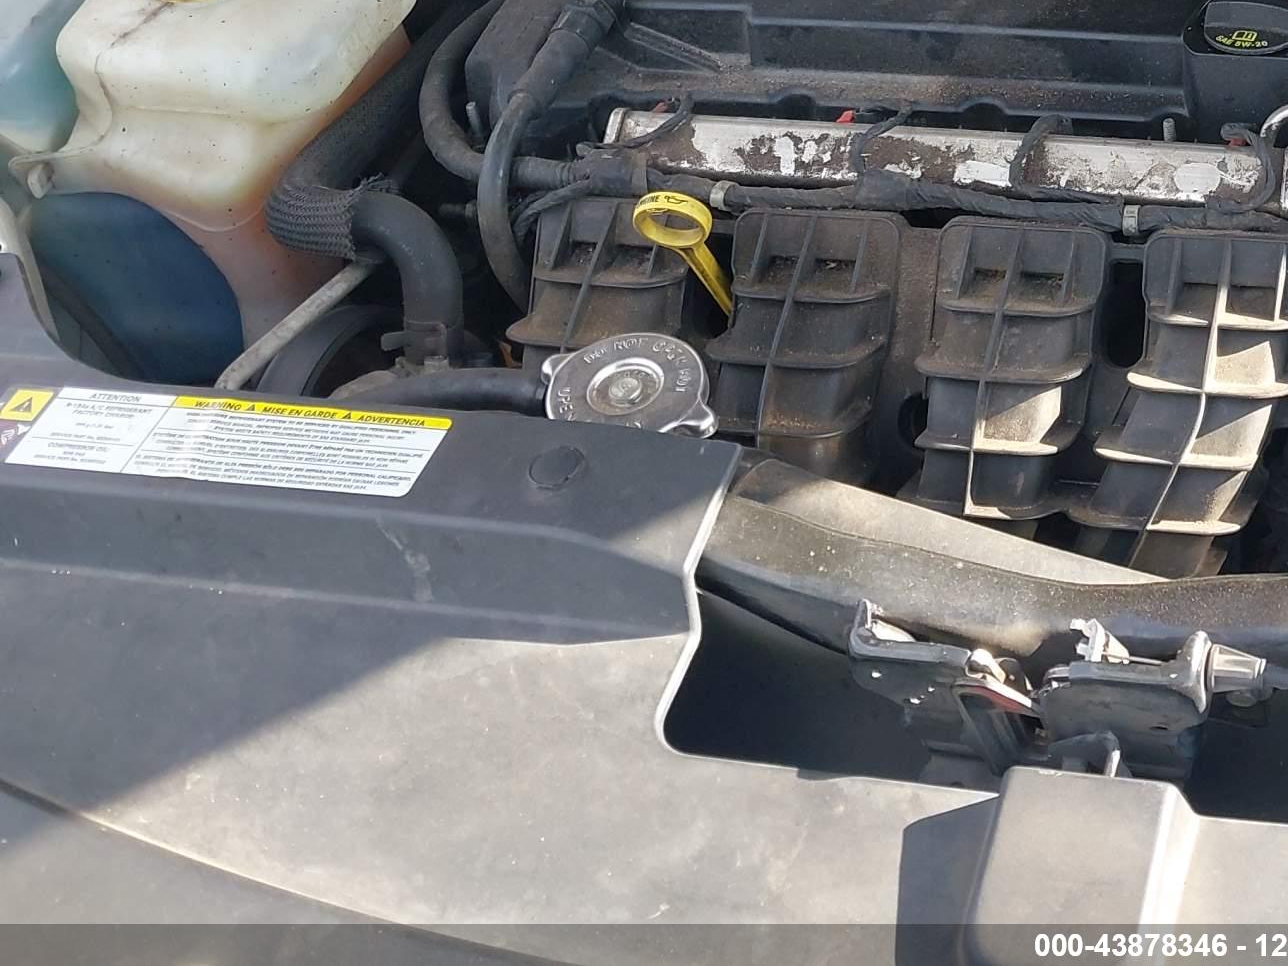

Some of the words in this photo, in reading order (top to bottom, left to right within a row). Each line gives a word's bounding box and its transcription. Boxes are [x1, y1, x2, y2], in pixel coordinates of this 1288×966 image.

[1215, 35, 1233, 46] SAE
[1234, 40, 1268, 48] 5W-20
[90, 393, 142, 403] ATTENTION
[302, 410, 338, 419] GARDE
[356, 414, 426, 426] ADVERTENCIA
